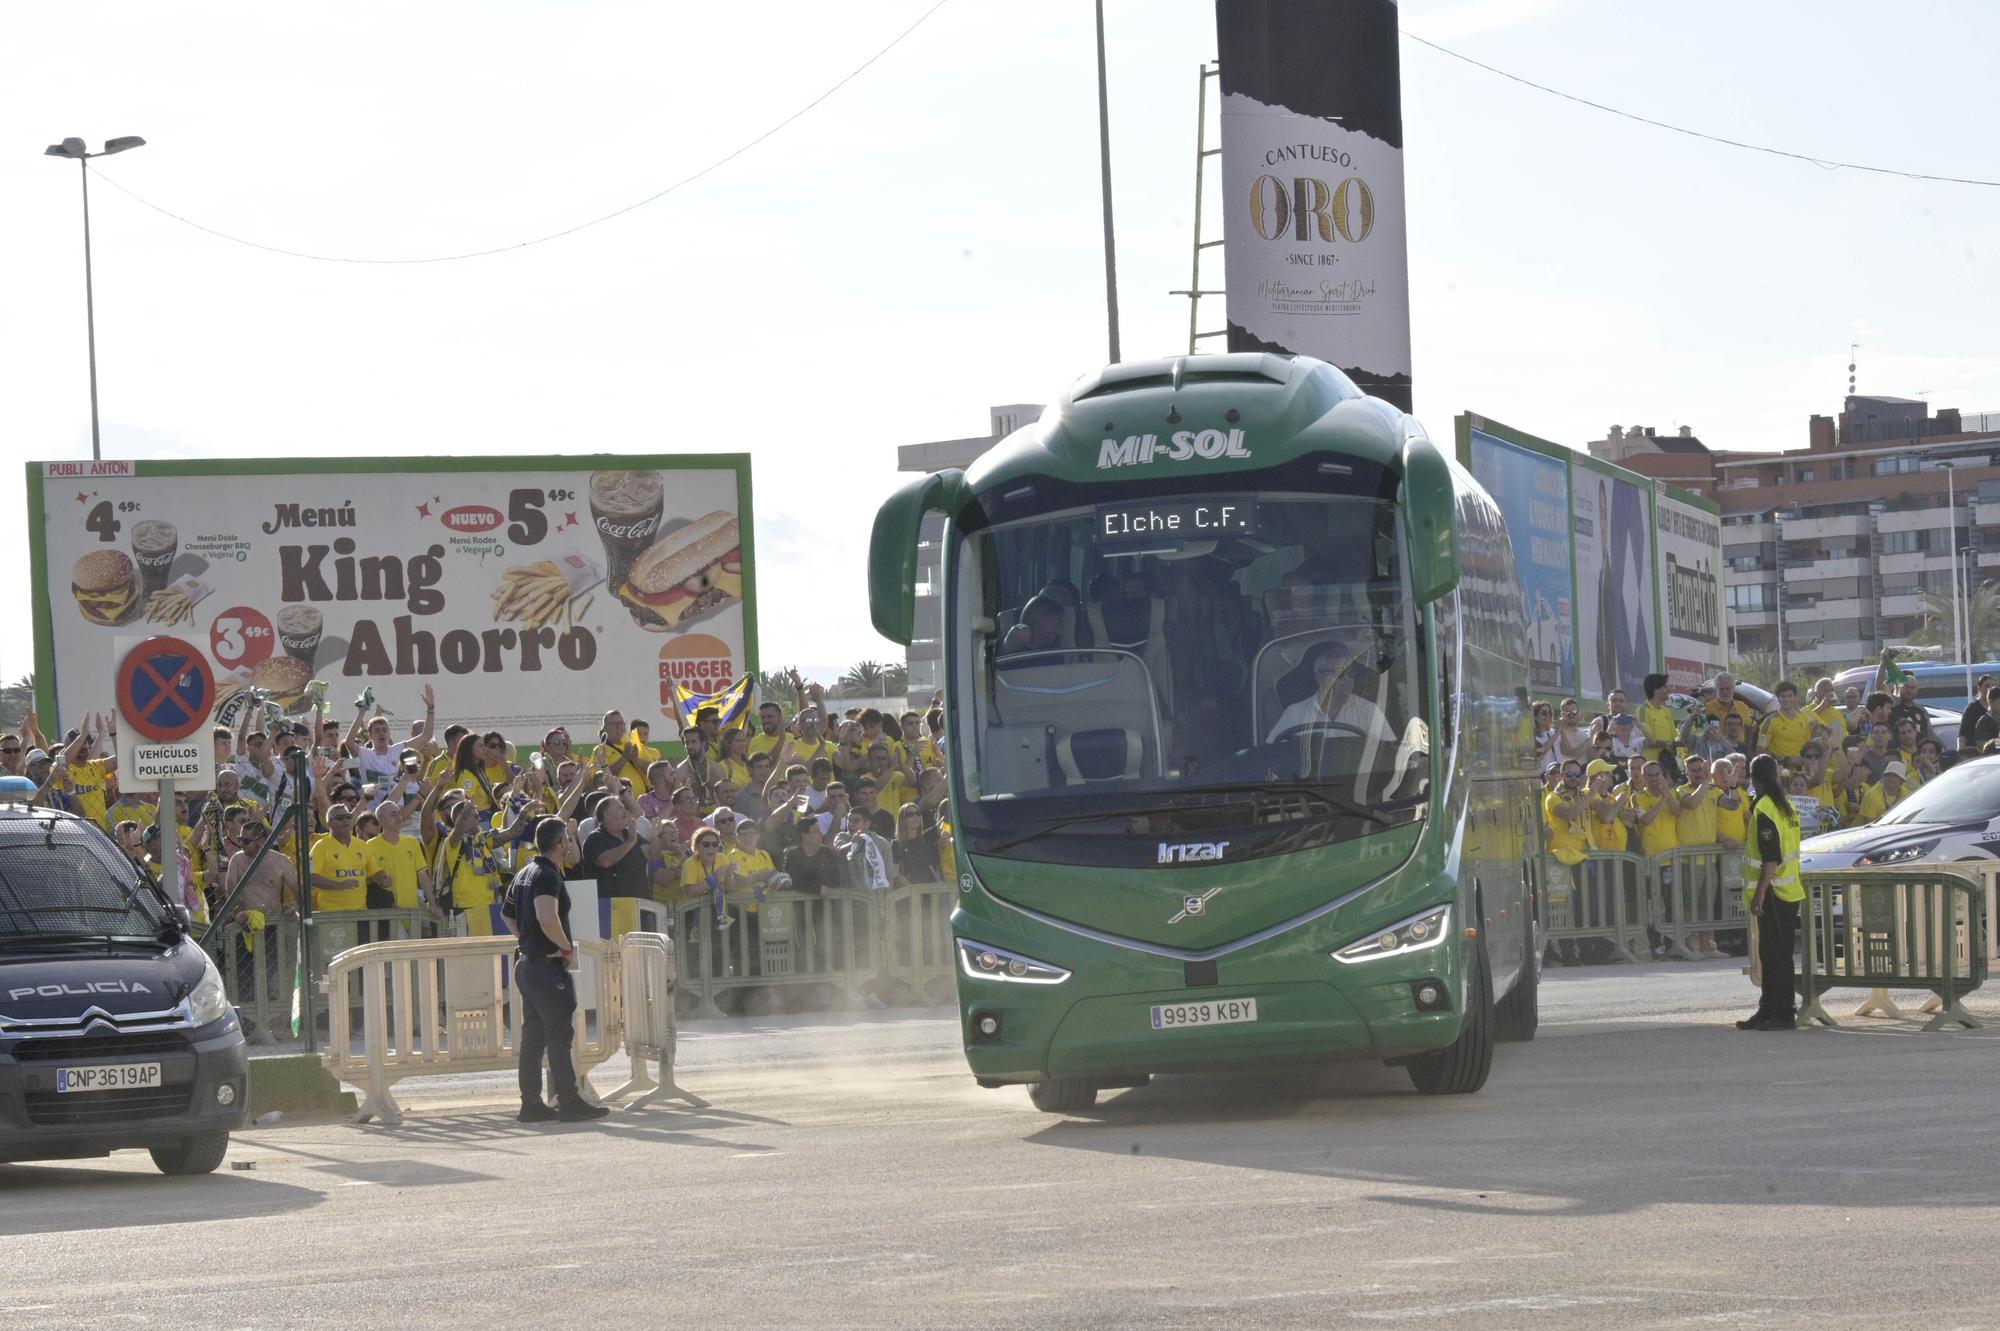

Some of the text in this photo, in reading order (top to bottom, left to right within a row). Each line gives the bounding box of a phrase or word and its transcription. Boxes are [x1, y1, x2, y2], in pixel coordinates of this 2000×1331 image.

[1265, 144, 1351, 168] CANTUESO
[1249, 174, 1375, 243] ORO
[1289, 254, 1335, 266] SINCE 1867
[1096, 428, 1252, 469] MI-SOL
[49, 462, 129, 476] PUBLI ANTON
[86, 500, 121, 542] 4
[262, 499, 356, 534] Menú
[450, 513, 495, 525] NUEVO
[507, 488, 548, 546] 5
[1105, 507, 1246, 534] Elche C.F.
[449, 536, 471, 545] Menú
[279, 537, 446, 615] King
[215, 617, 246, 660] 3
[342, 615, 597, 677] Ahorro
[658, 660, 733, 679] BURGER
[139, 764, 198, 776] POLICIALES
[8, 979, 152, 1001] POLICÍA
[1164, 1001, 1251, 1025] 9939 KBY
